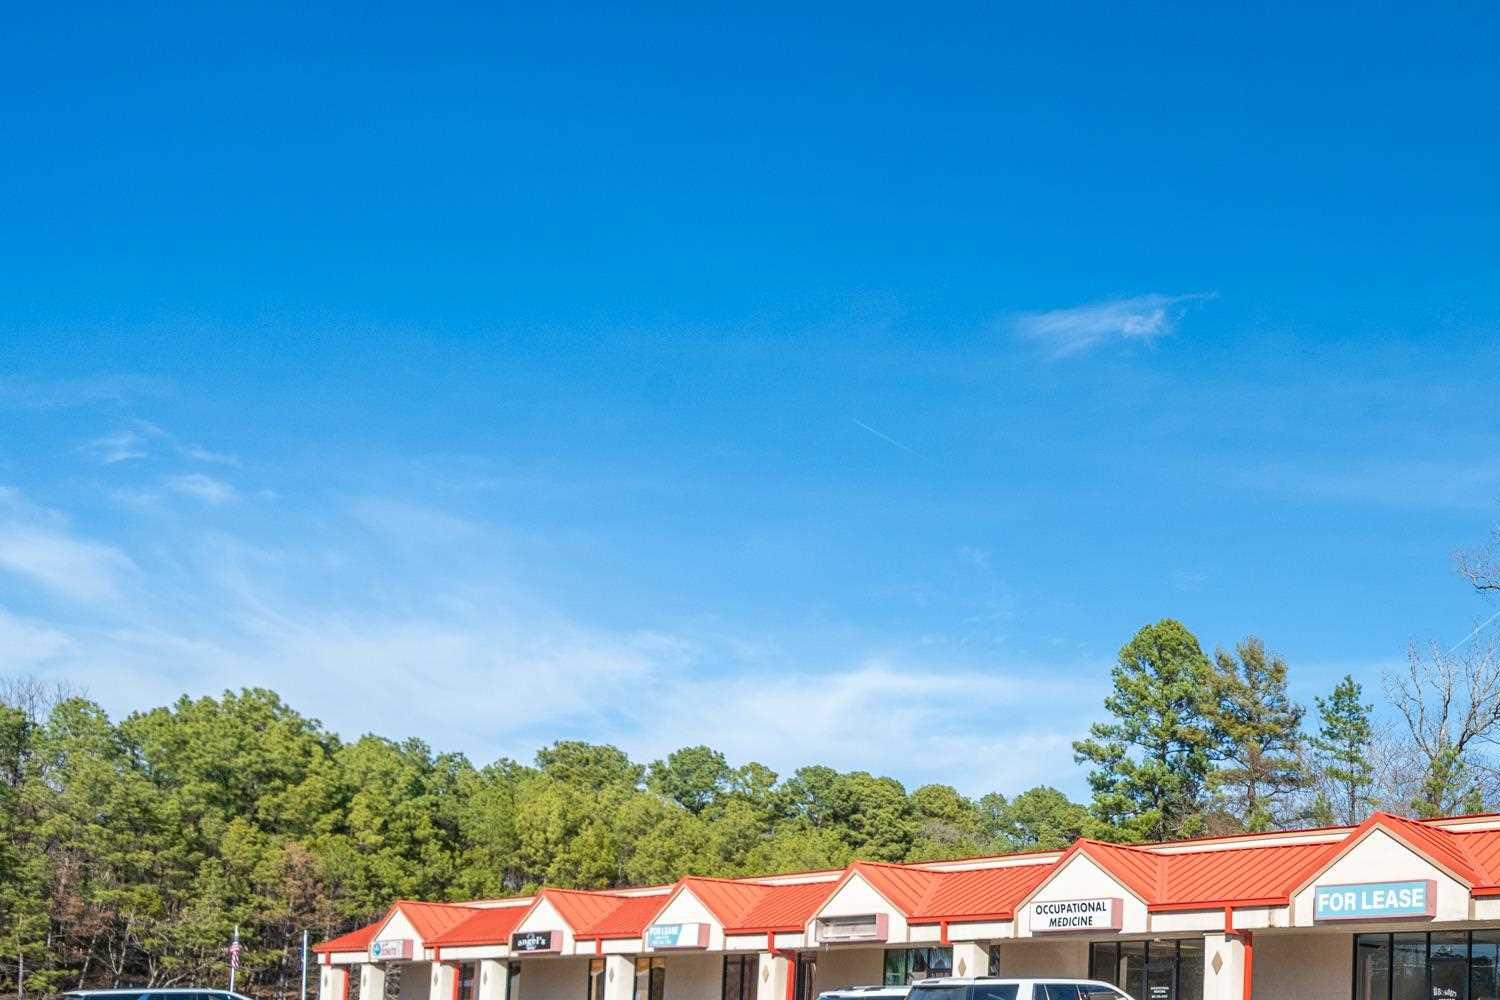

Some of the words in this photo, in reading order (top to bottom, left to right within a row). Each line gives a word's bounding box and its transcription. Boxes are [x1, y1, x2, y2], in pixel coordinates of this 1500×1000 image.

[1317, 892, 1357, 912] FOR
[1361, 888, 1424, 910] LEASE
[1035, 901, 1107, 915] OCCUPATIONAL
[1048, 915, 1093, 928] MEDICINE
